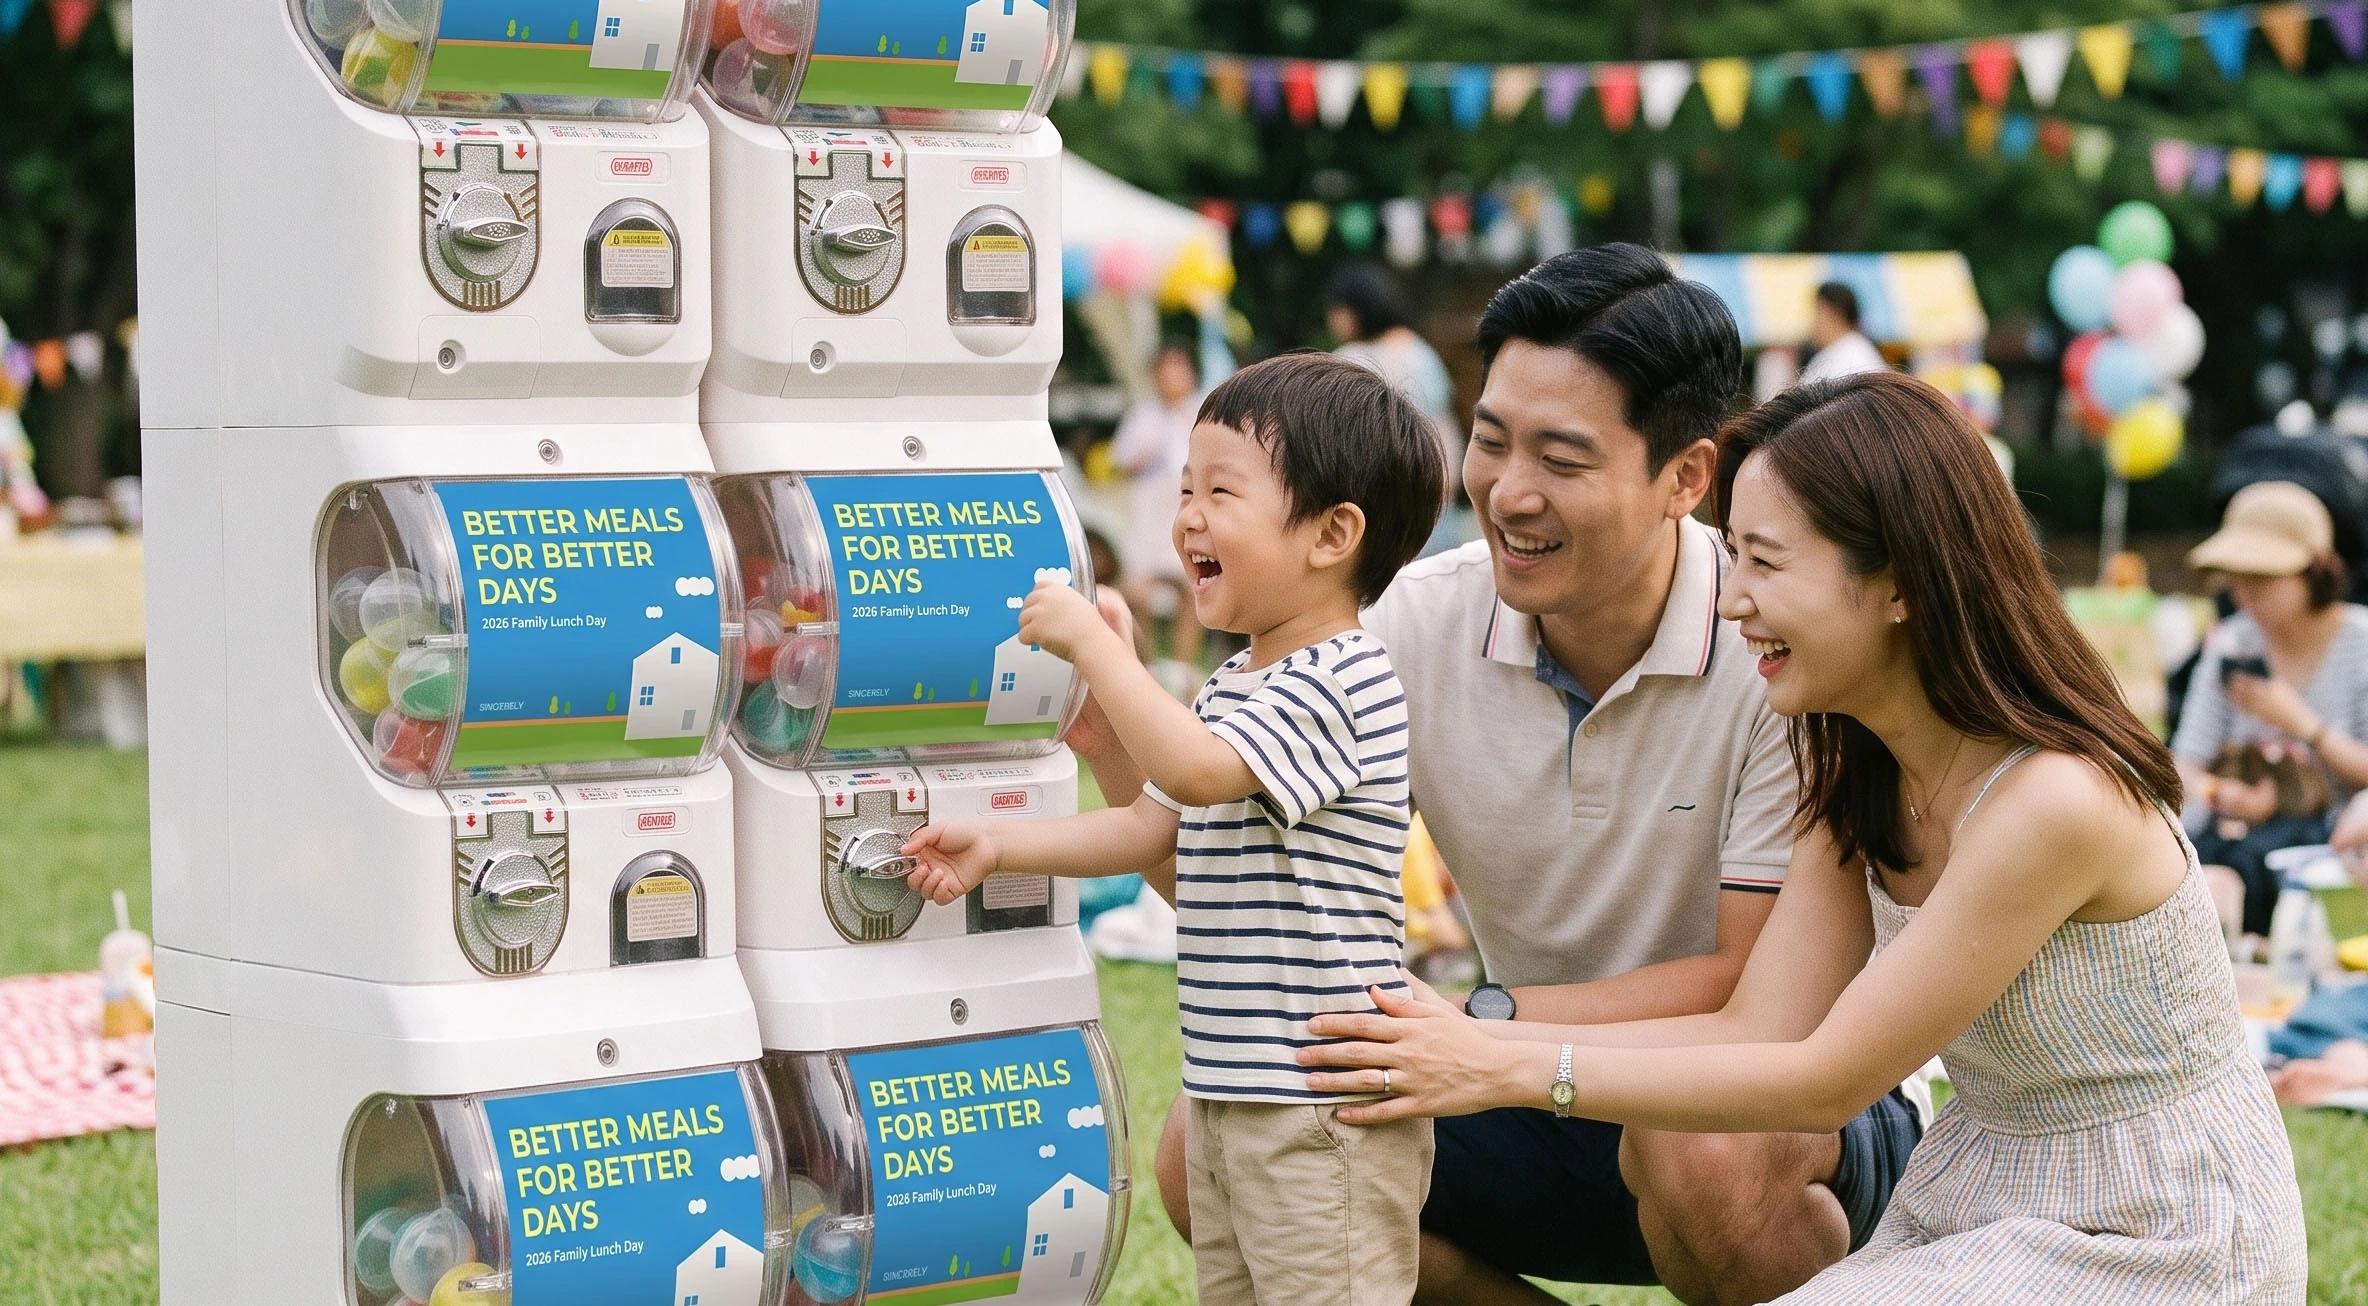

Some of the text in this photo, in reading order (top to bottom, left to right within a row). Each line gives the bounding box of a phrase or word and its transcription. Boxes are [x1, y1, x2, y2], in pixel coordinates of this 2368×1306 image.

[463, 507, 684, 535] BETTER MEALS
[833, 500, 1042, 527] BETTER MEALS
[472, 540, 655, 570] FOR BETTER
[842, 532, 1015, 560] FOR BETTER
[479, 577, 557, 604] DAYS
[848, 568, 923, 594] DAYS
[482, 615, 607, 630] 2026 Family Lunch Day
[852, 606, 878, 618] 2026
[917, 604, 948, 616] Lunch
[950, 604, 970, 617] Day
[870, 1059, 1071, 1107] BETTER MEALS
[509, 1104, 724, 1158] BETTER MEALS
[877, 1098, 1043, 1143] FOR BETTER
[516, 1148, 694, 1198] FOR BETTER
[883, 1145, 954, 1180] DAYS
[912, 1188, 945, 1203] Family
[946, 1183, 976, 1199] Lunch
[977, 1182, 997, 1196] Day
[522, 1200, 599, 1238] DAYS
[525, 1240, 644, 1266] 2026 Family Lunch Day
